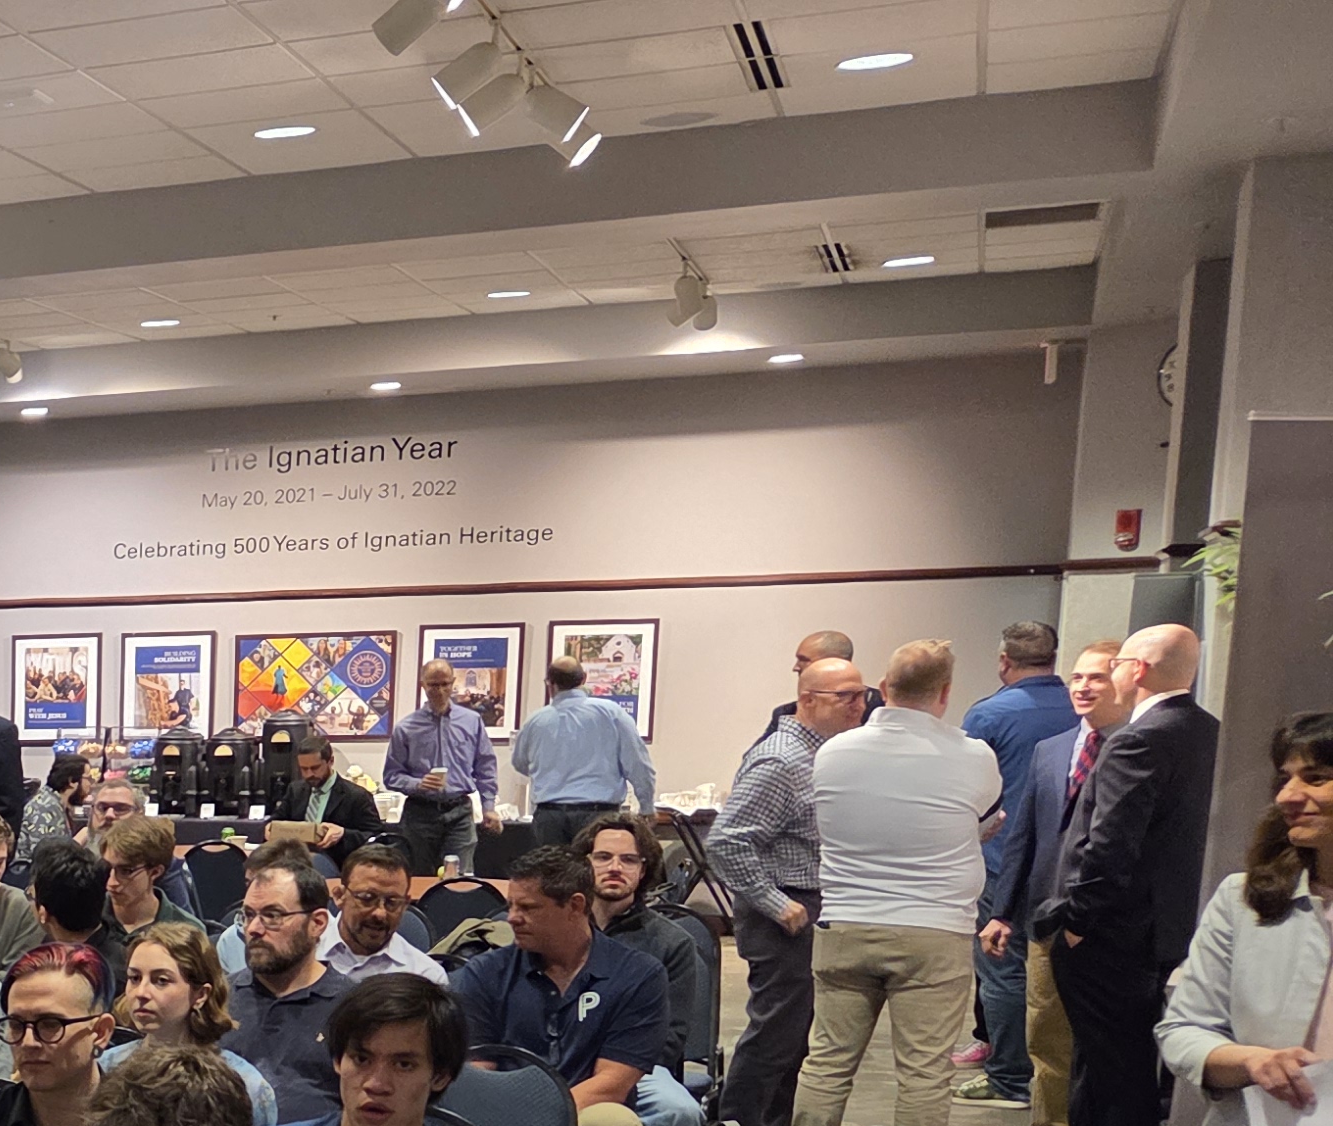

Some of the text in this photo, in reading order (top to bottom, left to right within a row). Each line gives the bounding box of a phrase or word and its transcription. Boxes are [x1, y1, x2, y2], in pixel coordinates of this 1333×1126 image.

[206, 436, 458, 474] The Ignatian Year
[201, 492, 238, 511] May
[242, 489, 268, 507] 20,
[274, 487, 316, 505] 2021
[337, 483, 373, 503] July
[377, 482, 405, 501] 31,
[411, 479, 457, 498] 2022
[113, 524, 554, 561] Celebrating 500 Years of Ignatian Heritage
[579, 991, 600, 1022] P
